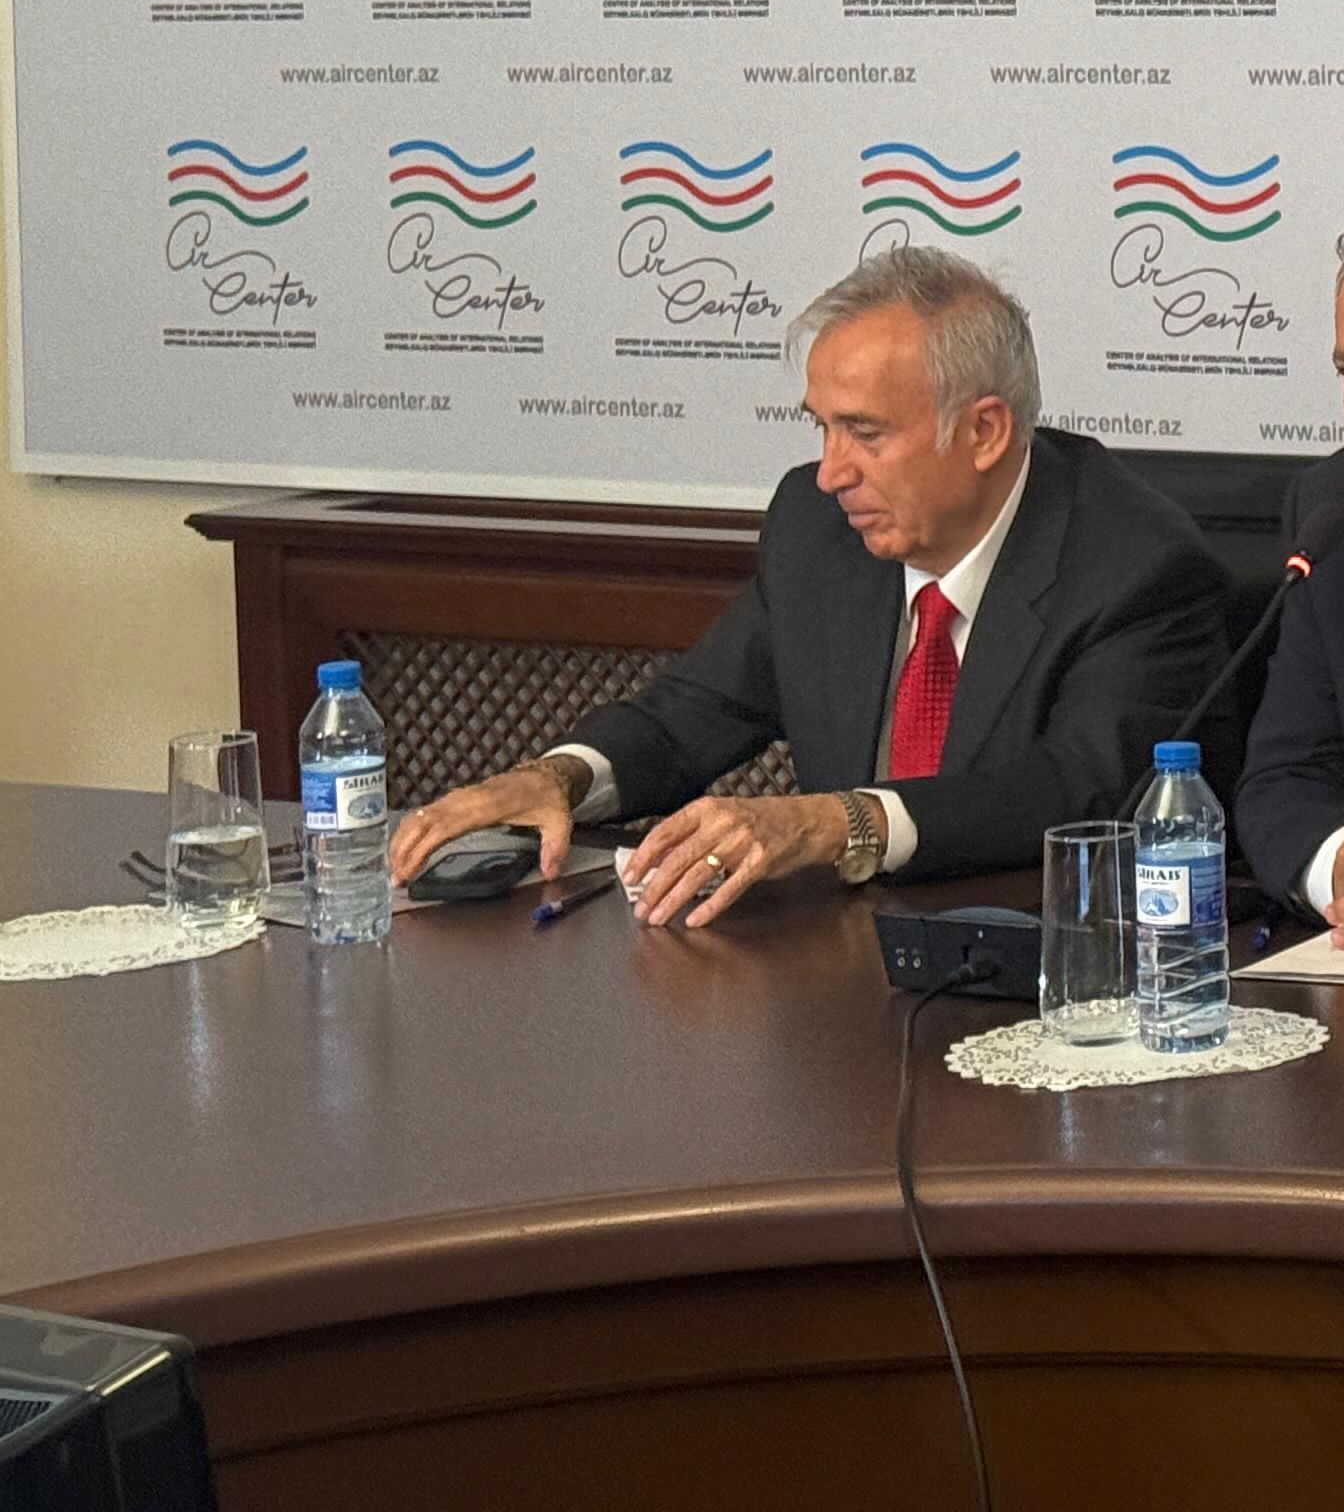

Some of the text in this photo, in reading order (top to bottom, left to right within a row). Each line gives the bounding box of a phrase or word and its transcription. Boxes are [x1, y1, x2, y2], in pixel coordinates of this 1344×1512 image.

[280, 64, 439, 84] www.aircenter.az
[507, 63, 673, 83] www.aircenter.az
[743, 62, 916, 83] www.aircenter.az
[990, 63, 1171, 85] www.aircenter.az
[202, 271, 318, 326] Center
[657, 279, 782, 337] Center
[1153, 290, 1290, 351] Center
[292, 390, 451, 411] www.aircenter.az
[519, 395, 685, 418] www.aircenter.az
